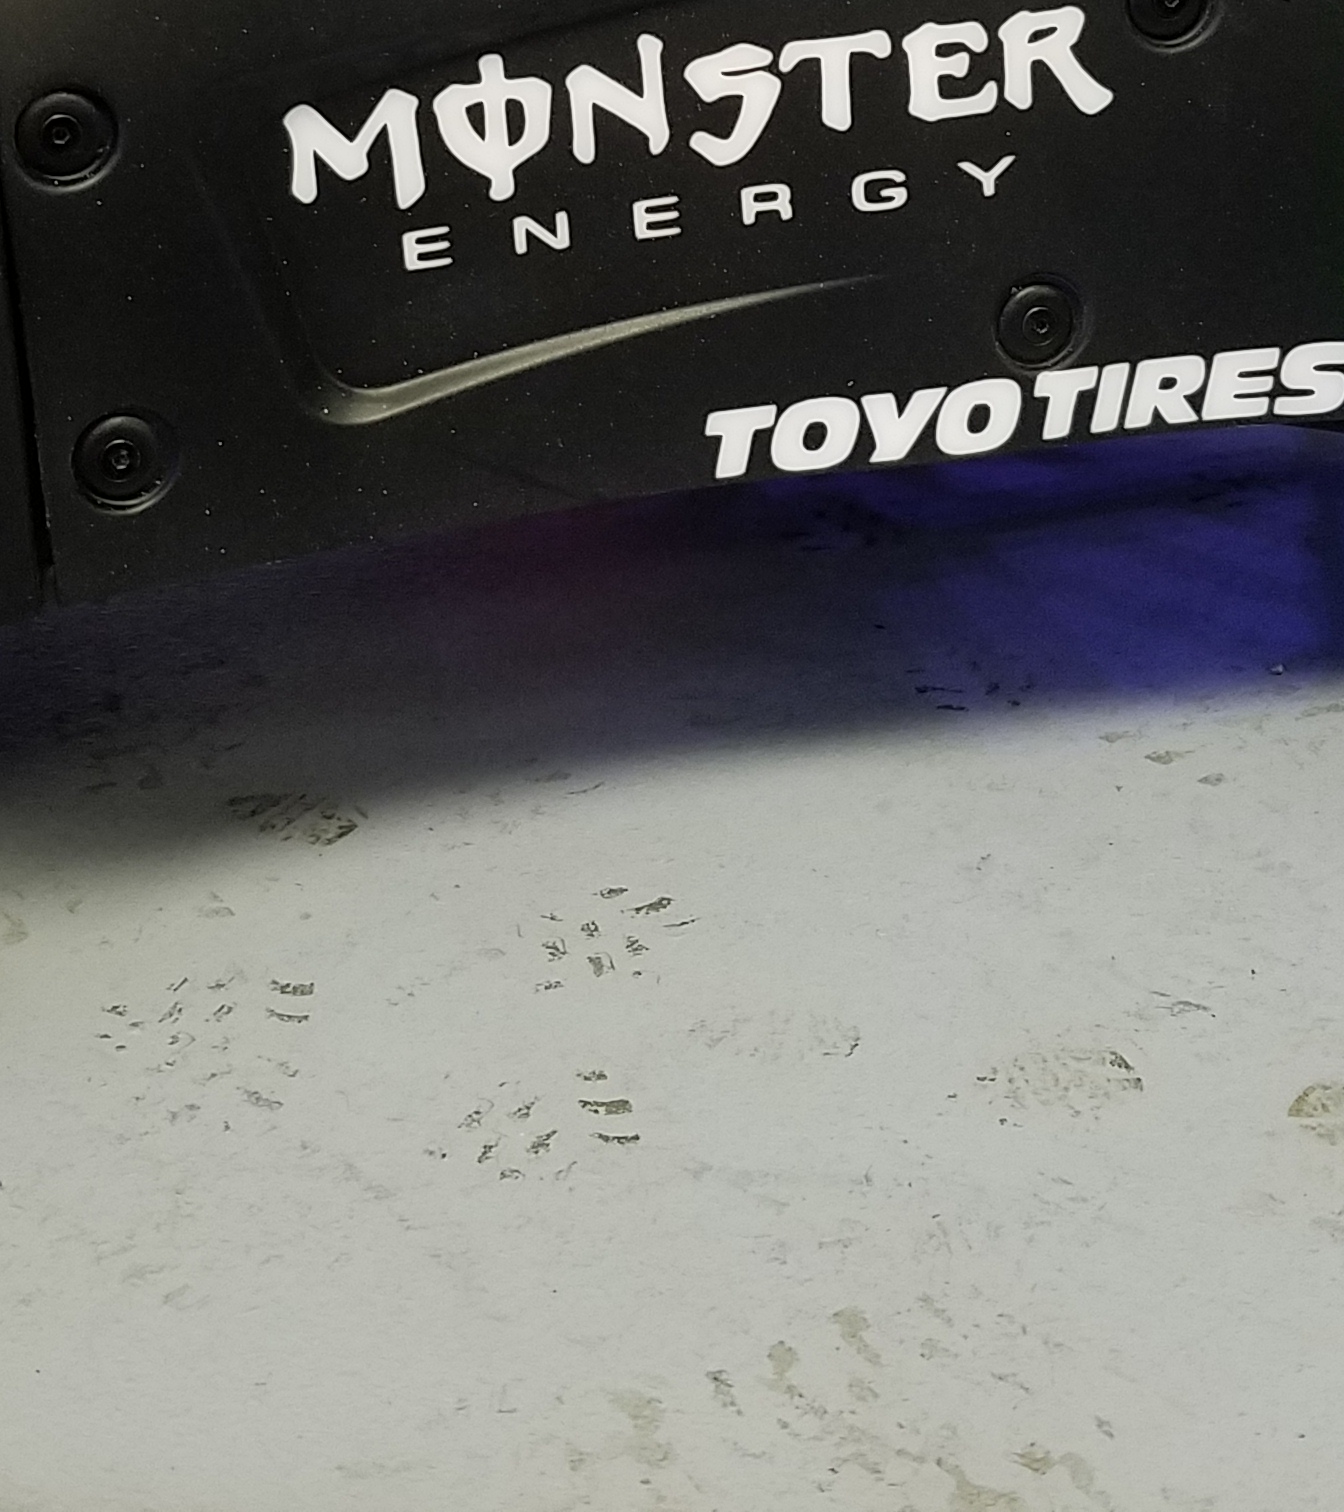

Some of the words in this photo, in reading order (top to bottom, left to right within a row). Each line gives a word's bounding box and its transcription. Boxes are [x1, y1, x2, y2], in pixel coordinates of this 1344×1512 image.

[282, 4, 1115, 211] MONSTER
[401, 153, 1017, 273] ENERGY
[703, 378, 1022, 480] TOYO
